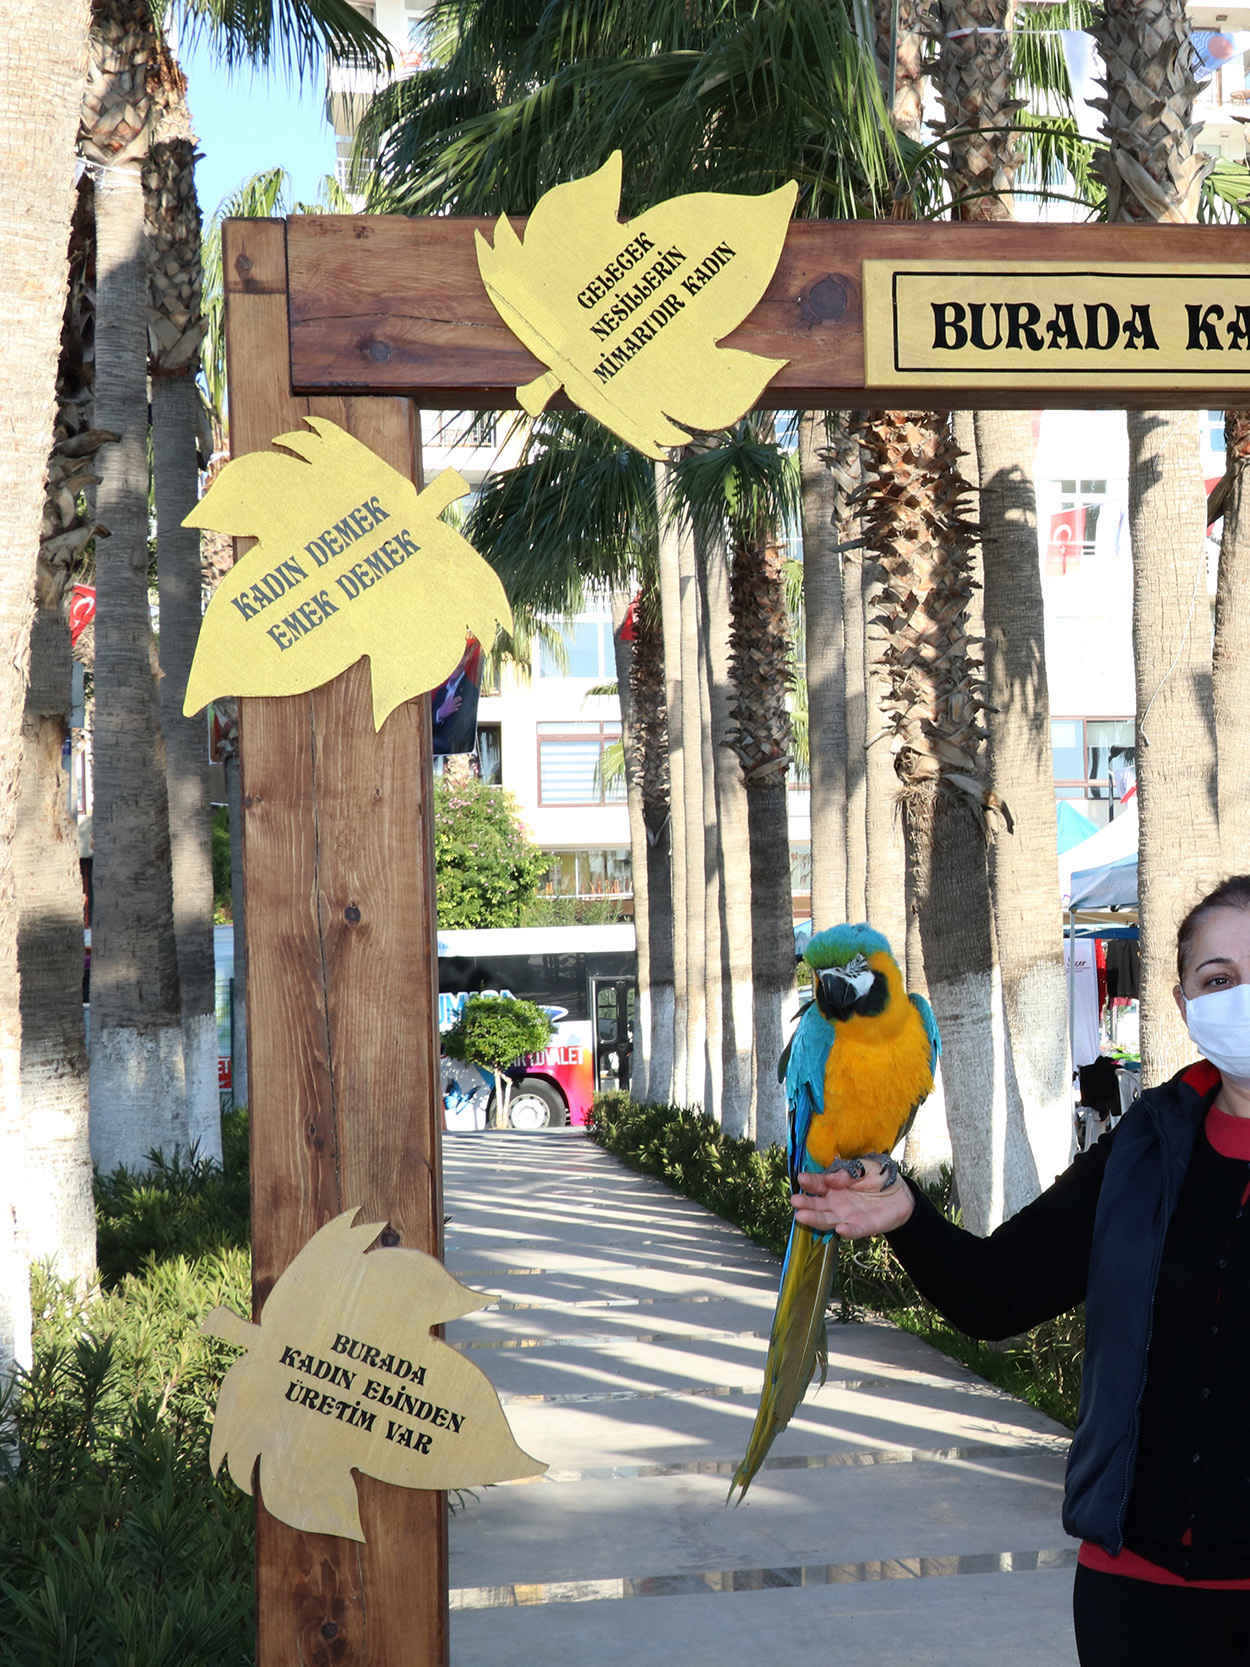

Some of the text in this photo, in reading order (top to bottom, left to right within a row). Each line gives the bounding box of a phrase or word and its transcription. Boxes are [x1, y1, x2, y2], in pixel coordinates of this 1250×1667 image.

[576, 231, 656, 310] GELECEK
[589, 245, 687, 342] NESİLLERİN
[680, 240, 736, 297] KADIN
[930, 301, 1160, 351] BURADA
[230, 496, 391, 622] KADIN DEMEK
[266, 528, 422, 652] EMEK DEMEK
[278, 1345, 466, 1434] KADIN ELİNDEN
[330, 1332, 428, 1387] BURADA
[284, 1379, 434, 1455] ÜRETİM VAR
